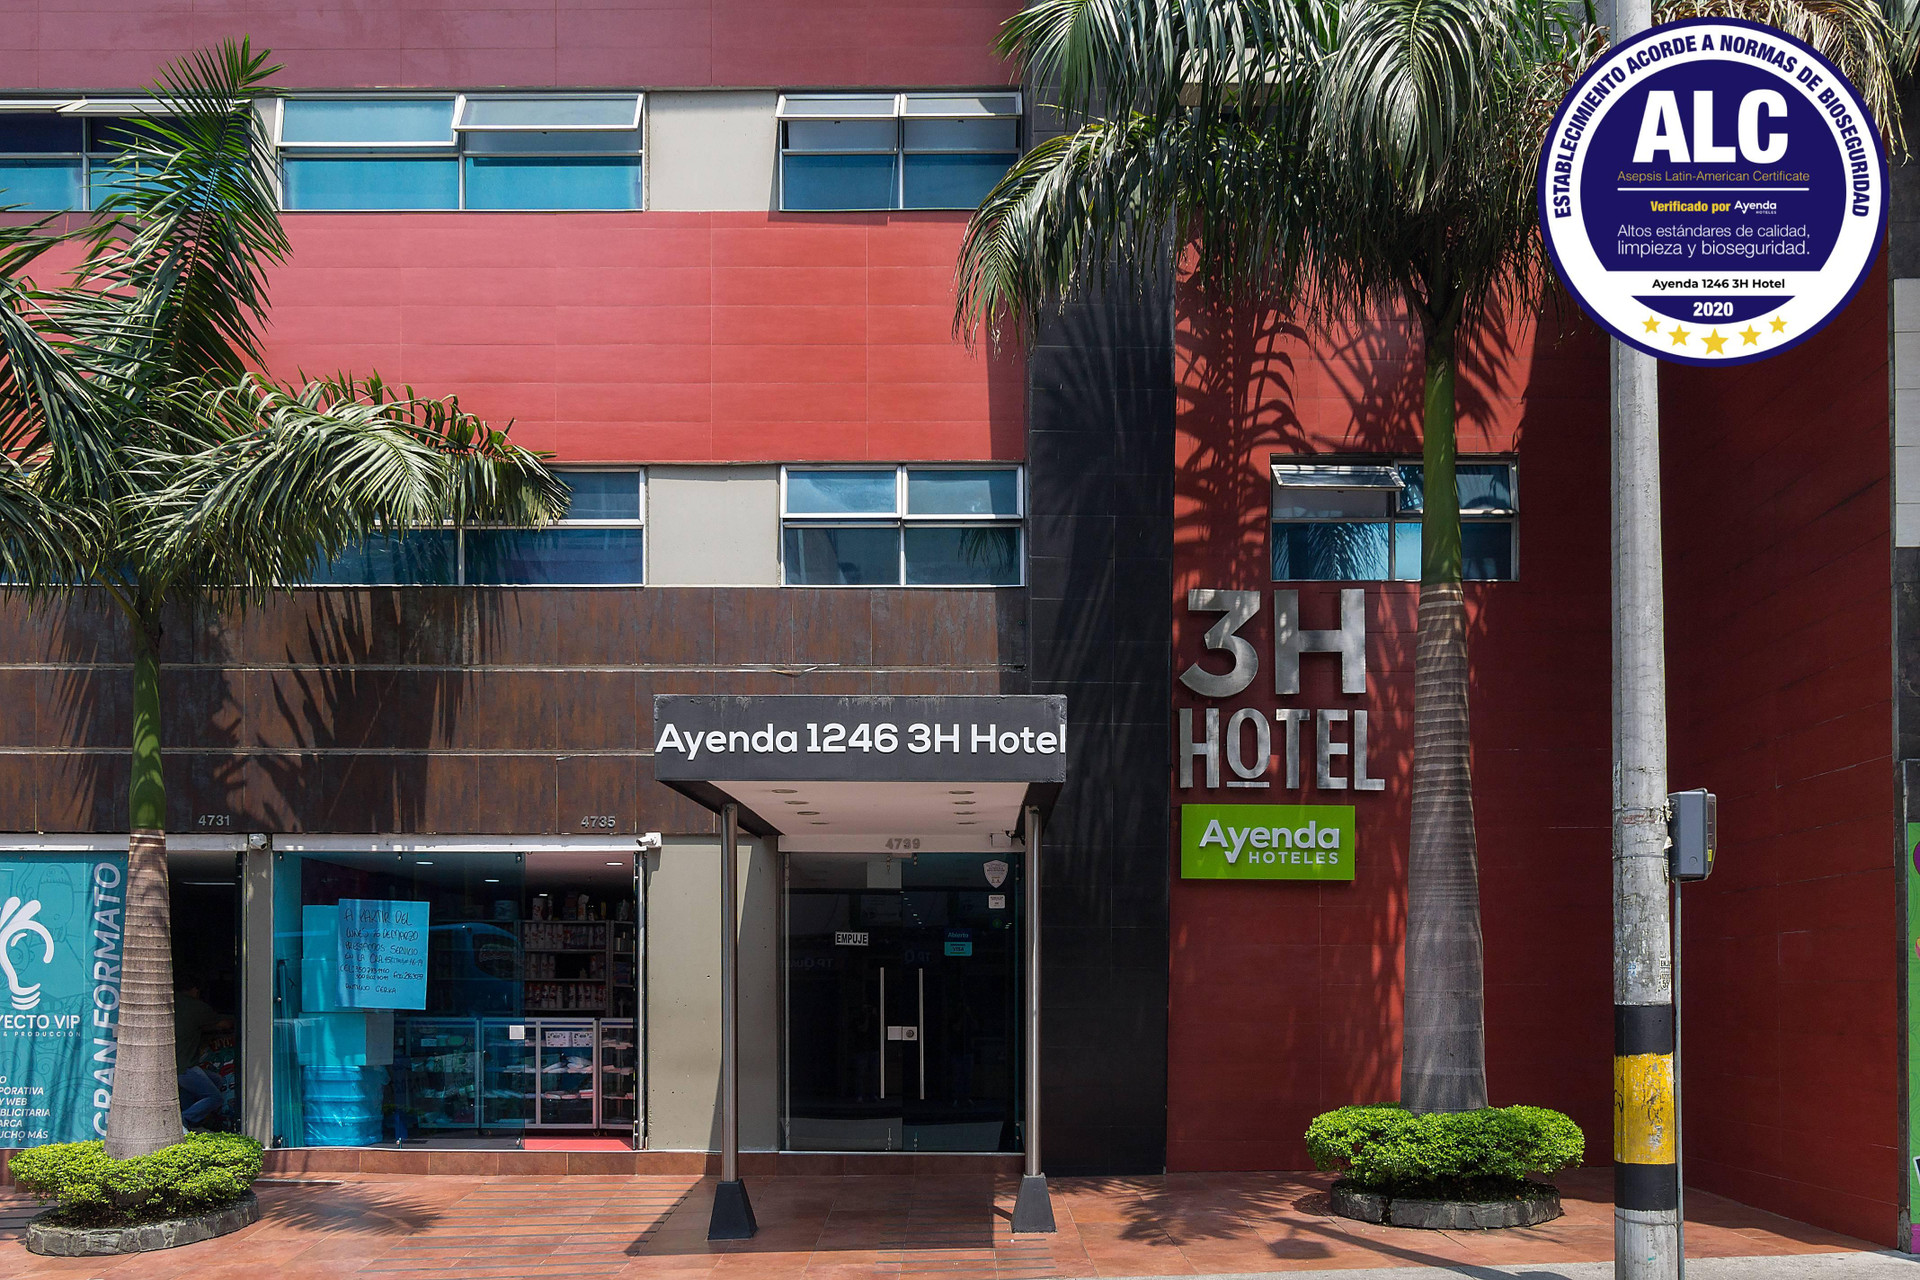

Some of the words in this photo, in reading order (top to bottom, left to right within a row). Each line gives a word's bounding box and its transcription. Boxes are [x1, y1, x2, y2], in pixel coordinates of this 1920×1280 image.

[1179, 588, 1367, 698] 3H
[654, 723, 798, 761] Ayenda
[805, 723, 899, 754] 1246
[907, 723, 960, 754] 3H
[970, 724, 1066, 754] Hotel
[1179, 708, 1386, 791] HOTEL
[198, 814, 231, 826] 4731
[580, 815, 617, 829] 4735
[1199, 819, 1340, 864] Ayenda
[1249, 851, 1339, 864] HOTELES
[836, 933, 868, 944] EMPUJE
[93, 862, 121, 1038] FORMATO
[54, 1014, 81, 1029] VIP
[93, 1037, 118, 1137] GRAN
[6, 1097, 28, 1106] WEB
[27, 1128, 49, 1139] MÁS
